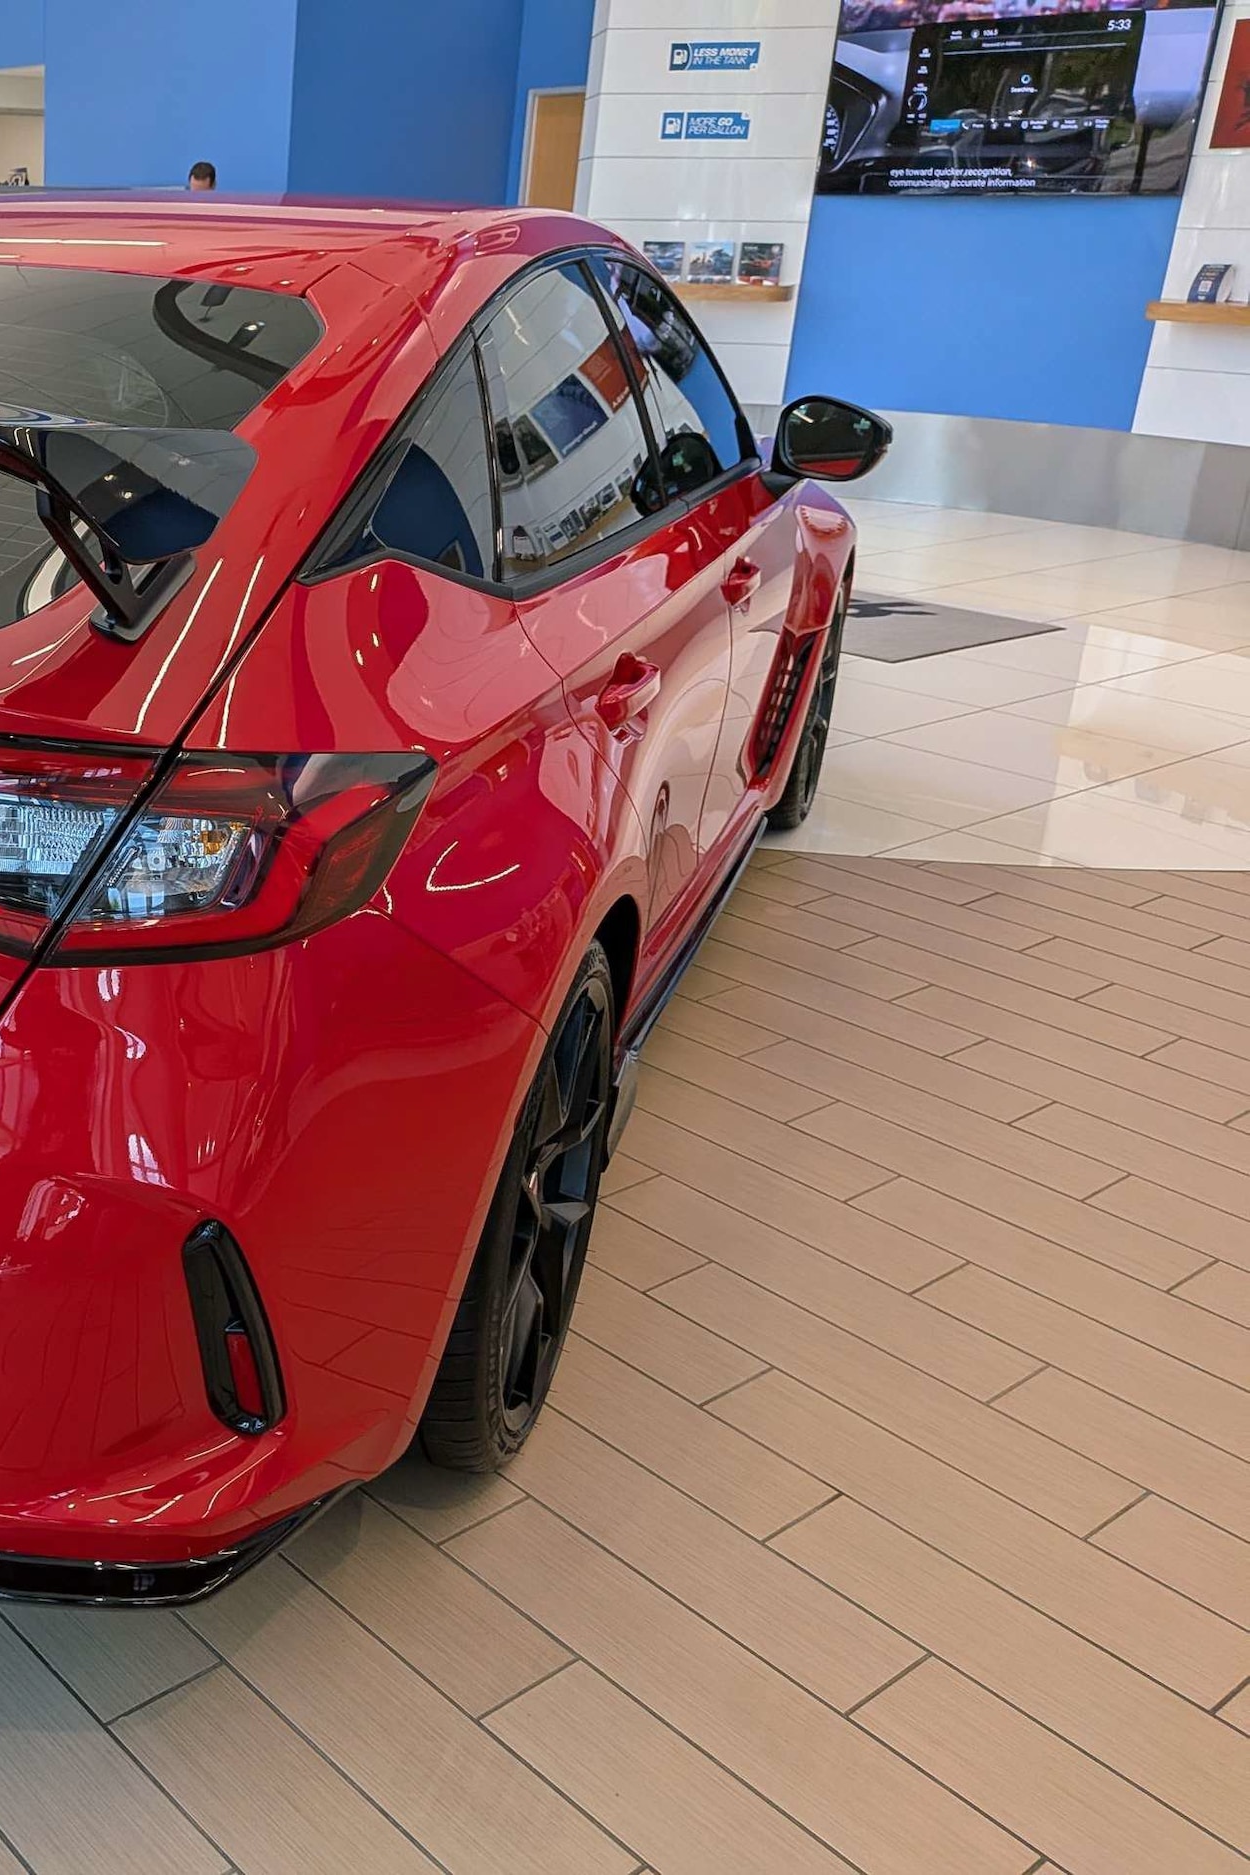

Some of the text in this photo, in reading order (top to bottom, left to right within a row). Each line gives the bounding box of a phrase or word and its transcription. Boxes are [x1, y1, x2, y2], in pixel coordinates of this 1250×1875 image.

[693, 47, 757, 57] LESS MONEY
[692, 56, 747, 65] IN THE TANK
[688, 117, 734, 126] MORE GO
[687, 125, 746, 135] PER GALLON
[889, 169, 904, 177] eye
[905, 168, 933, 177] toward
[888, 178, 1036, 189] communicating accurate information
